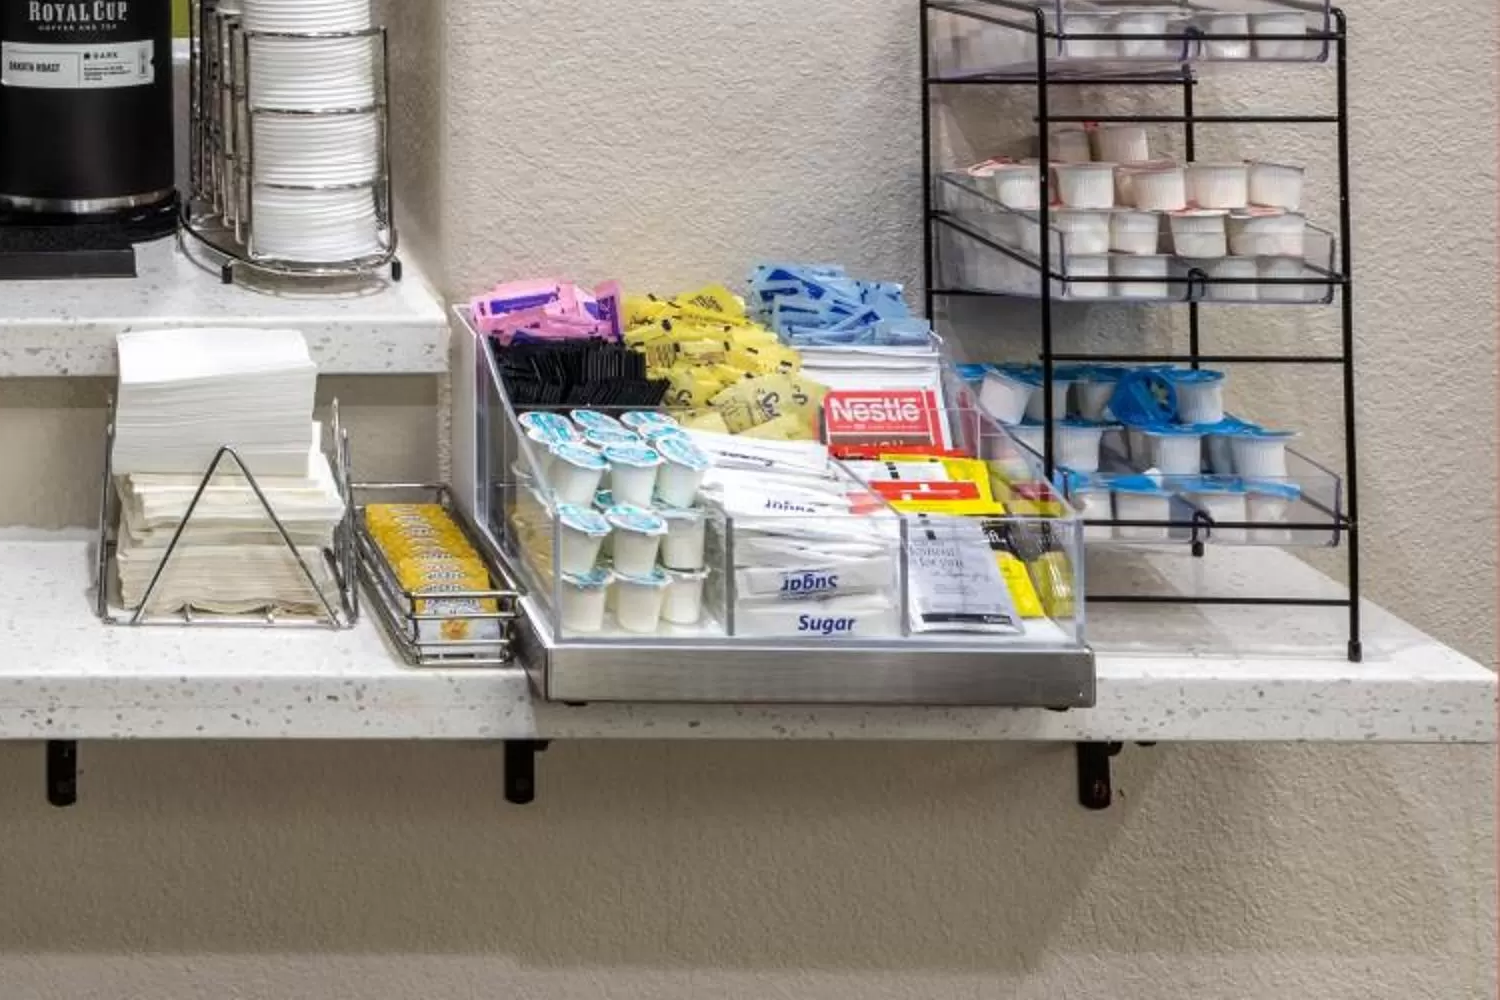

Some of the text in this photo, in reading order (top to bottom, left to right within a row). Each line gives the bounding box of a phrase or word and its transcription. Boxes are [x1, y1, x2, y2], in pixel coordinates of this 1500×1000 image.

[29, 0, 127, 21] ROYAL CUP
[780, 573, 839, 591] Sugar
[798, 614, 857, 635] Sugar
